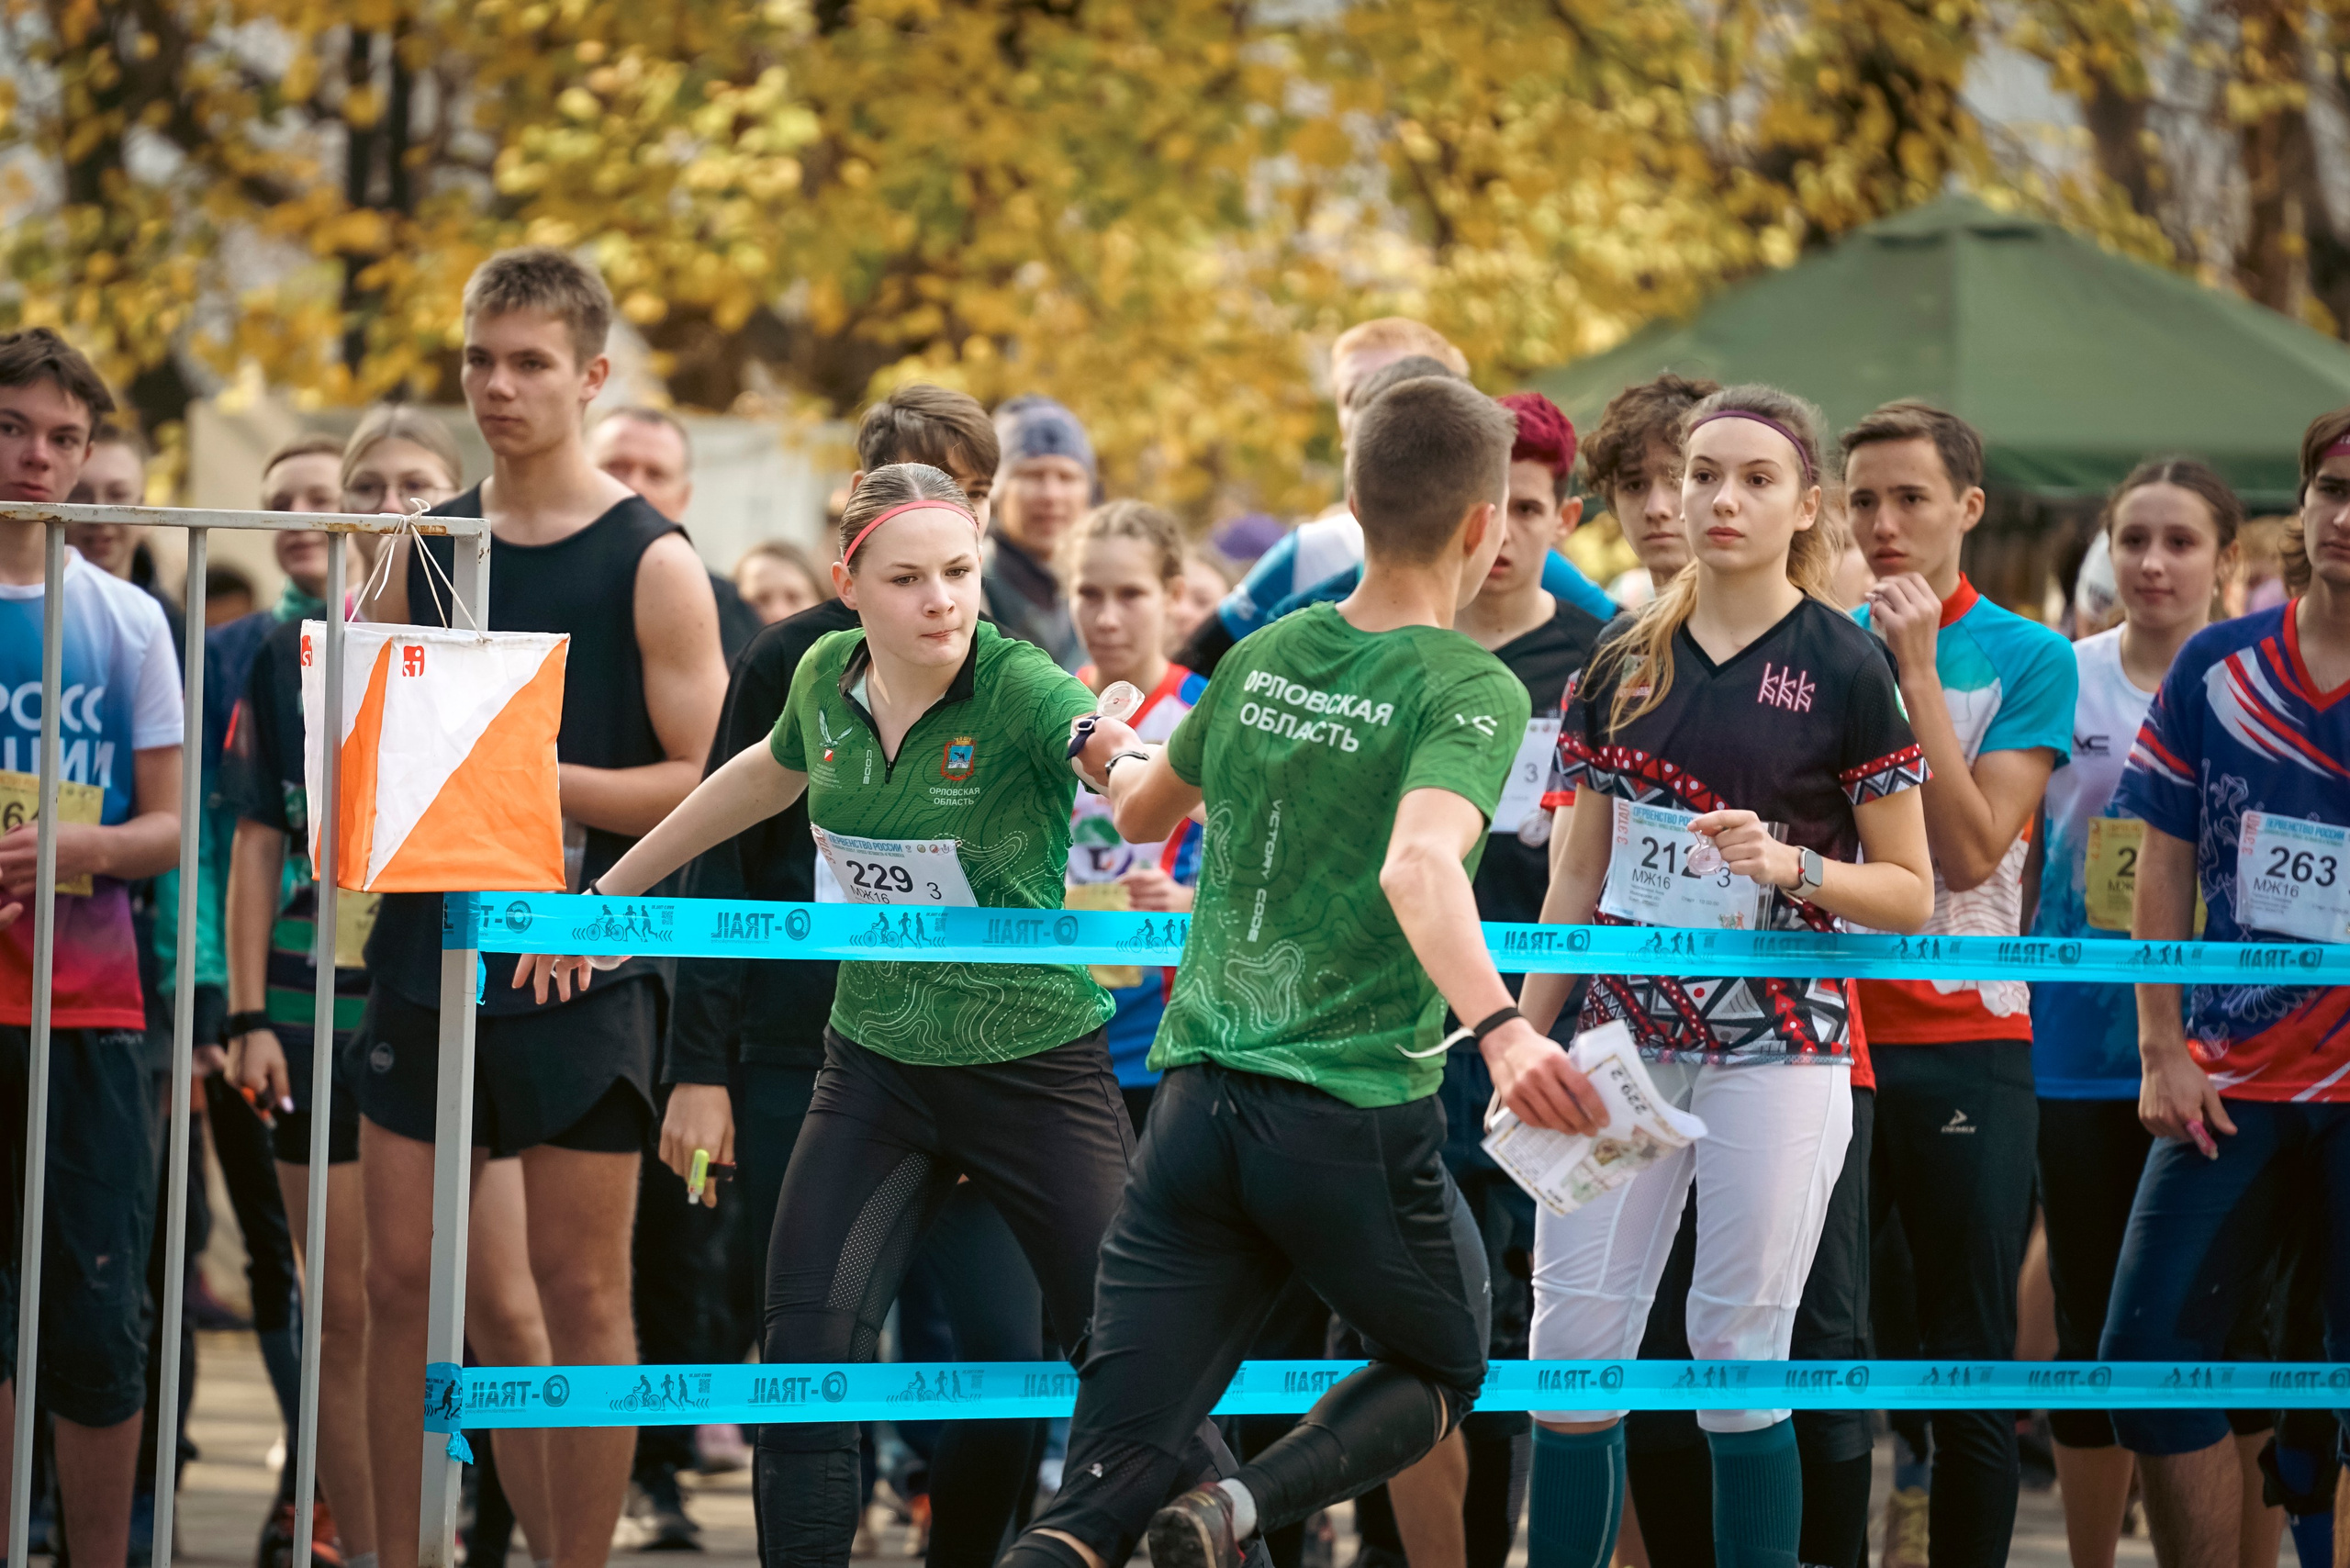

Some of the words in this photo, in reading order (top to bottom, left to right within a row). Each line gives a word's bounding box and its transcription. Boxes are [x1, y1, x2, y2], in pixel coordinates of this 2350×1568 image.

[1244, 670, 1394, 726] ОРЛОВСКАЯ
[1239, 702, 1359, 753] ОБЛАСТЬ
[863, 750, 872, 784] CODE
[1525, 763, 1539, 783] 3
[929, 787, 980, 796] ОРЛОВСКАЯ
[934, 797, 975, 806] ОБЛАСТЬ
[1633, 807, 1677, 824] ПЕРВЕНСТВО
[829, 834, 872, 850] ПЕРВЕНСТВО
[872, 842, 902, 852] РОССИИ
[1261, 799, 1282, 880] VICTORY
[846, 860, 913, 893] 229
[2266, 846, 2337, 887] 263
[1632, 868, 1671, 890] МЖ16
[1717, 868, 1731, 888] 3
[2254, 877, 2300, 898] МЖ16
[850, 884, 890, 904] МЖ16
[926, 882, 942, 900] 3
[1247, 888, 1267, 942] CODE
